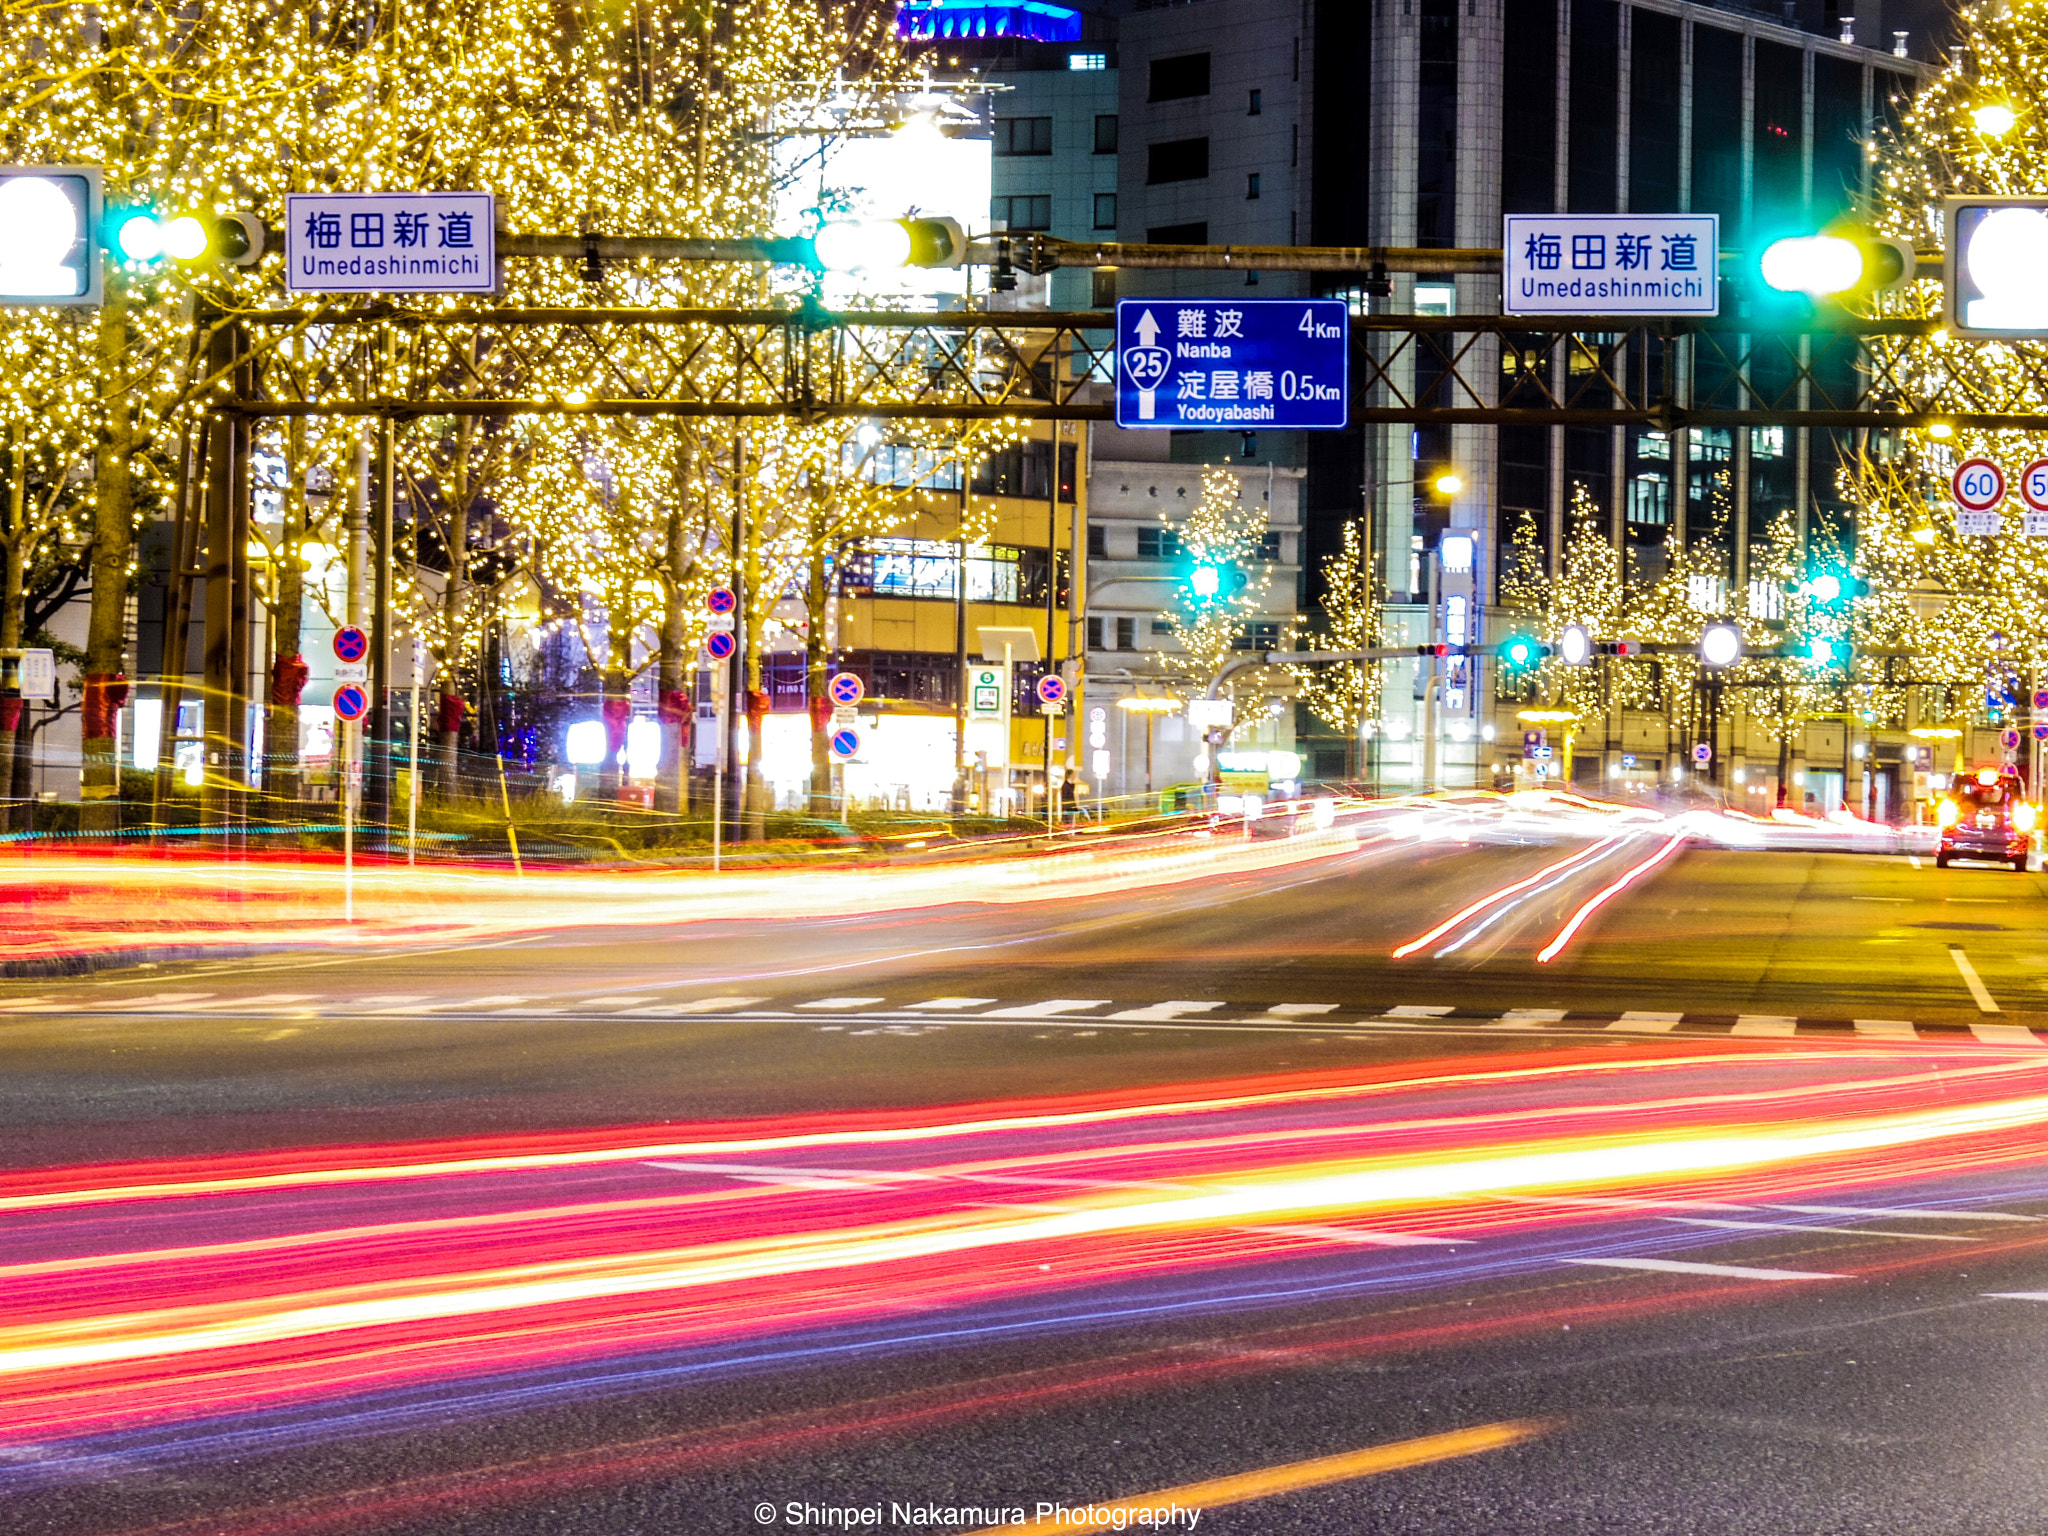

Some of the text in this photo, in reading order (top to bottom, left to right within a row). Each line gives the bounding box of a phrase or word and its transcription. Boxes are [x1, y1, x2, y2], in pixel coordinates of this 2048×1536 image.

[305, 210, 474, 249] 梅田新道
[1524, 232, 1698, 271] 梅田新道
[302, 254, 479, 275] Umedashinmichi
[1522, 277, 1702, 297] Umedashinmichi
[1177, 308, 1244, 338] 難波
[1177, 342, 1231, 359] Nanba
[1132, 352, 1162, 378] 25
[1177, 370, 1274, 400] 淀屋橋
[1177, 404, 1275, 423] Yodoyabashi
[1964, 473, 1993, 496] 60
[2033, 474, 2048, 496] 5
